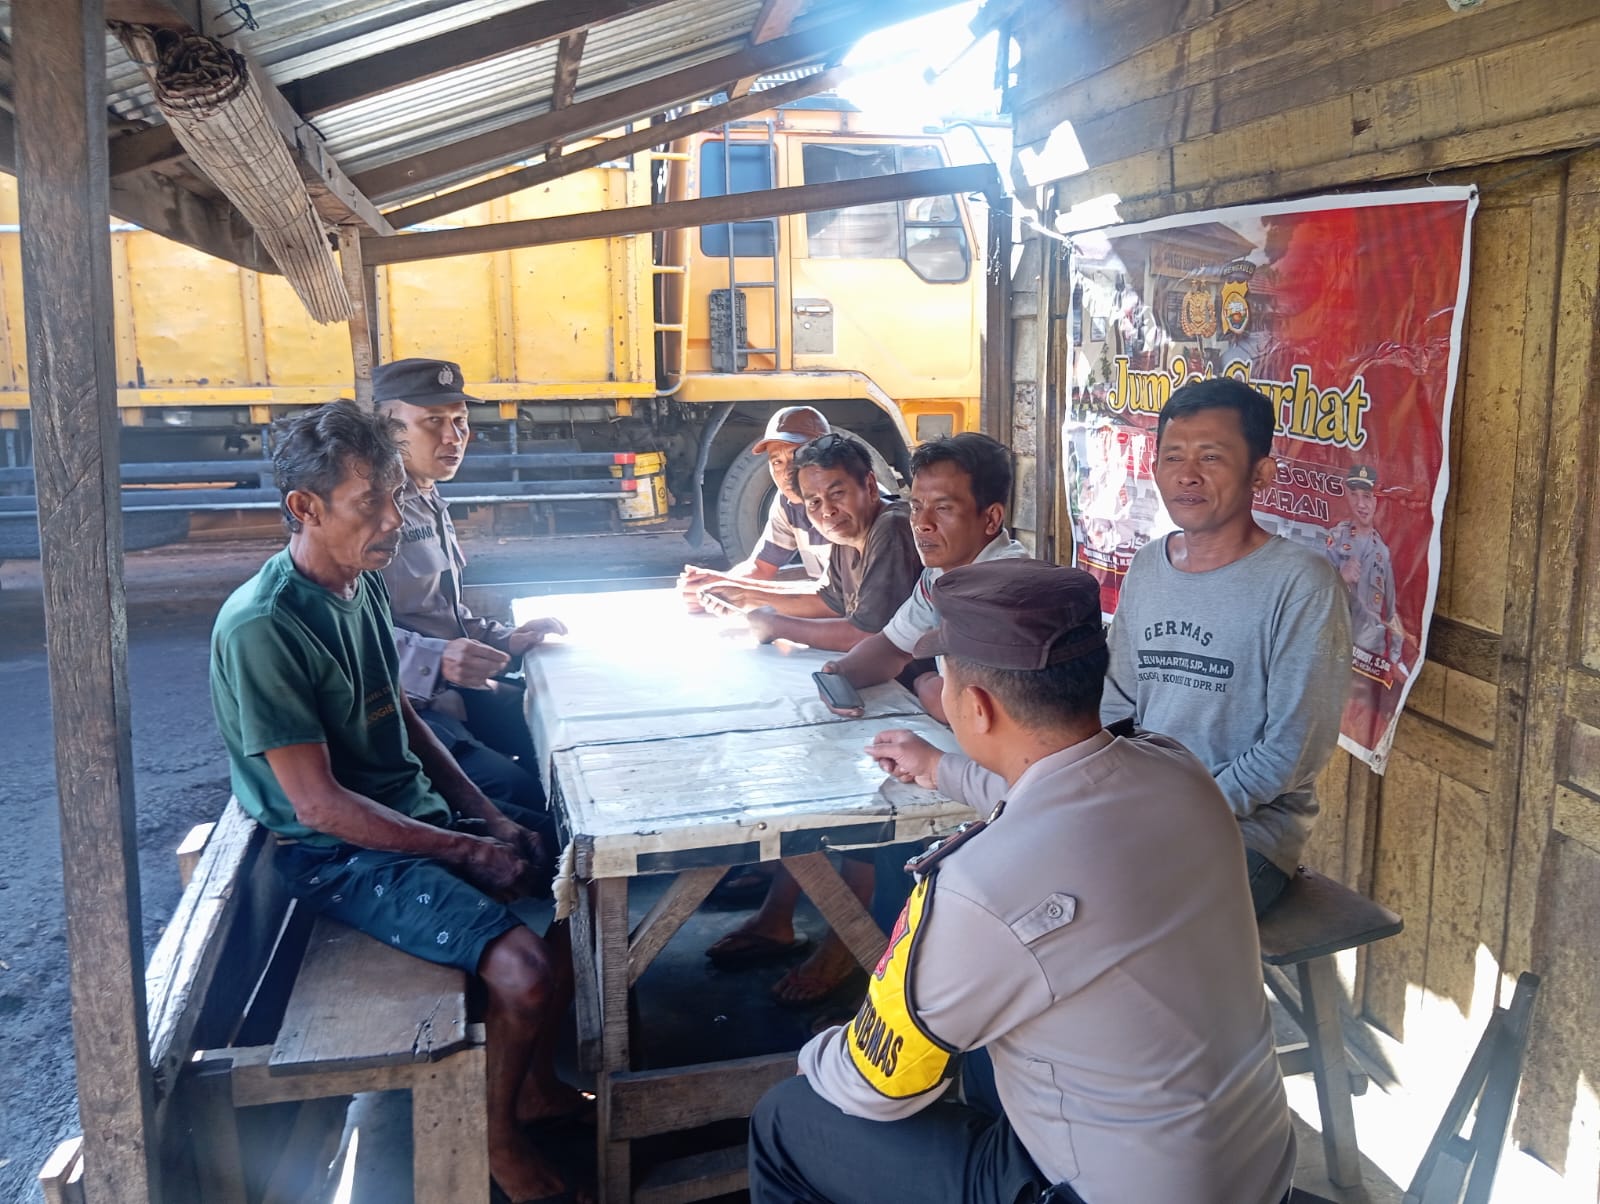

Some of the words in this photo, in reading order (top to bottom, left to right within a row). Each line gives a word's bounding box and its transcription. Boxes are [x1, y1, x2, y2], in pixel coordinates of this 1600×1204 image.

[1107, 356, 1214, 414] Jum'
[1223, 359, 1371, 448] rhat
[1275, 463, 1345, 497] BONG
[1253, 487, 1329, 522] JARAN
[1144, 620, 1213, 647] GERMAS
[1193, 679, 1213, 692] DPR
[1215, 682, 1227, 693] RI
